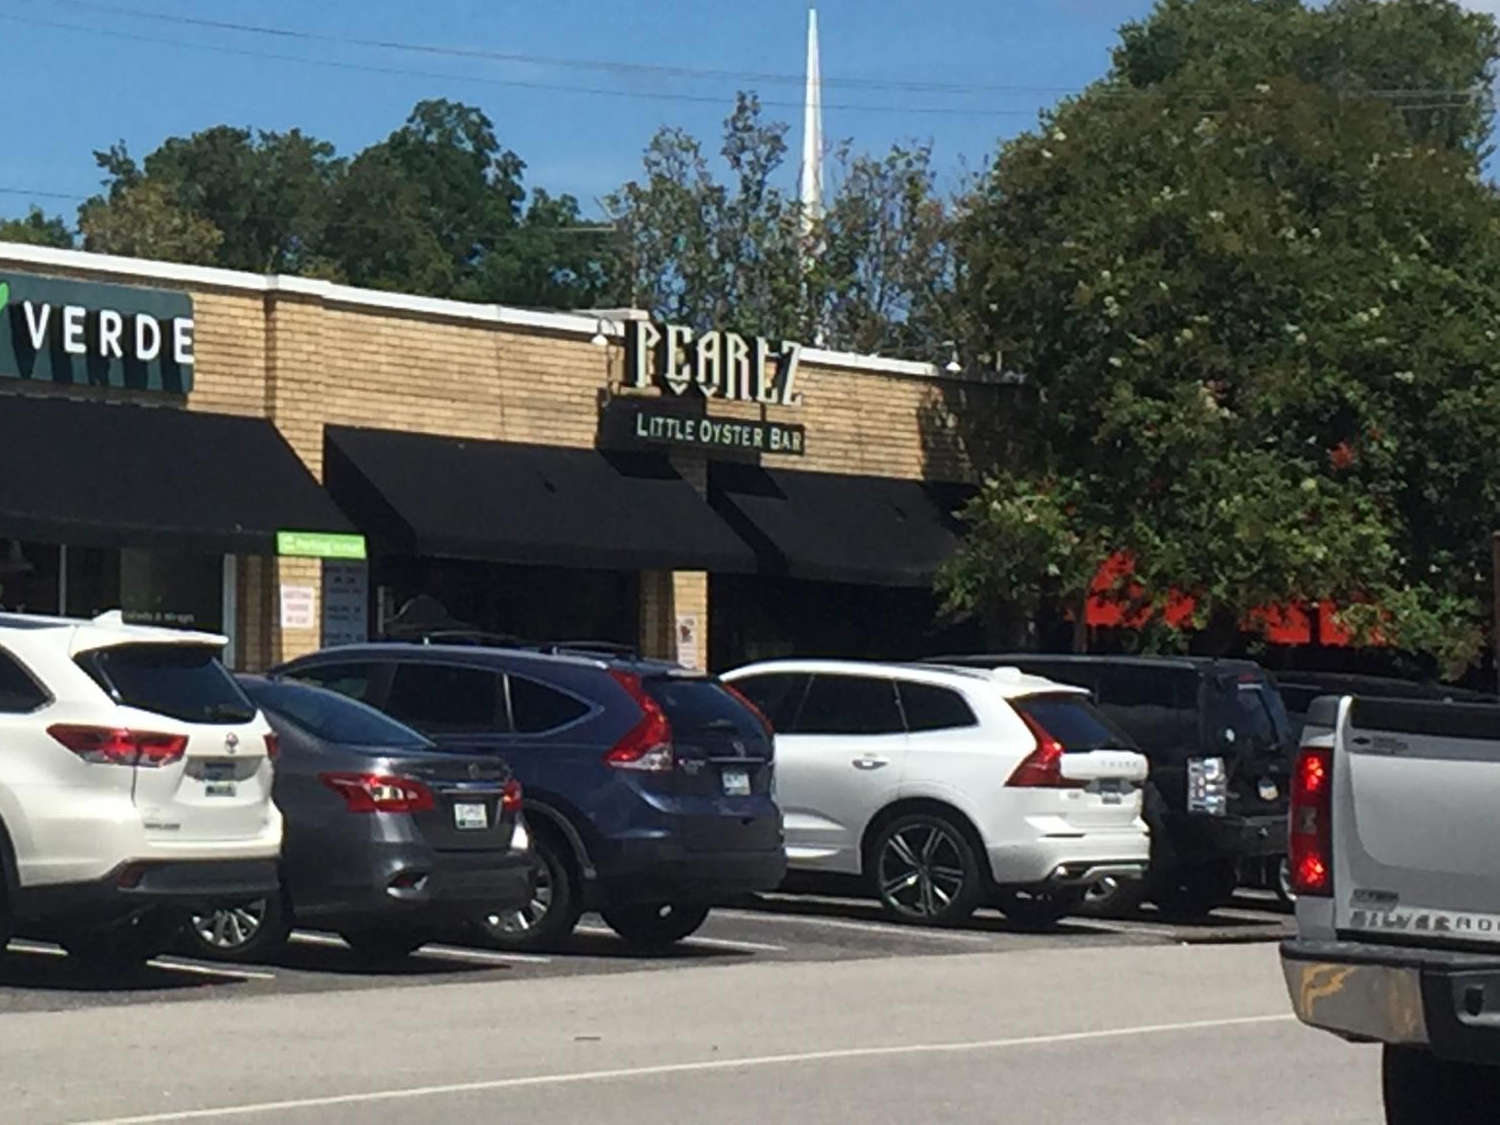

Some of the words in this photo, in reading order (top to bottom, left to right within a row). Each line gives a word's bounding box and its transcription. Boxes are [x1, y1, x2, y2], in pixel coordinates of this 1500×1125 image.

[23, 300, 194, 364] VERDE
[635, 320, 803, 406] PEARLZ
[1350, 910, 1500, 933] SILVERAD
